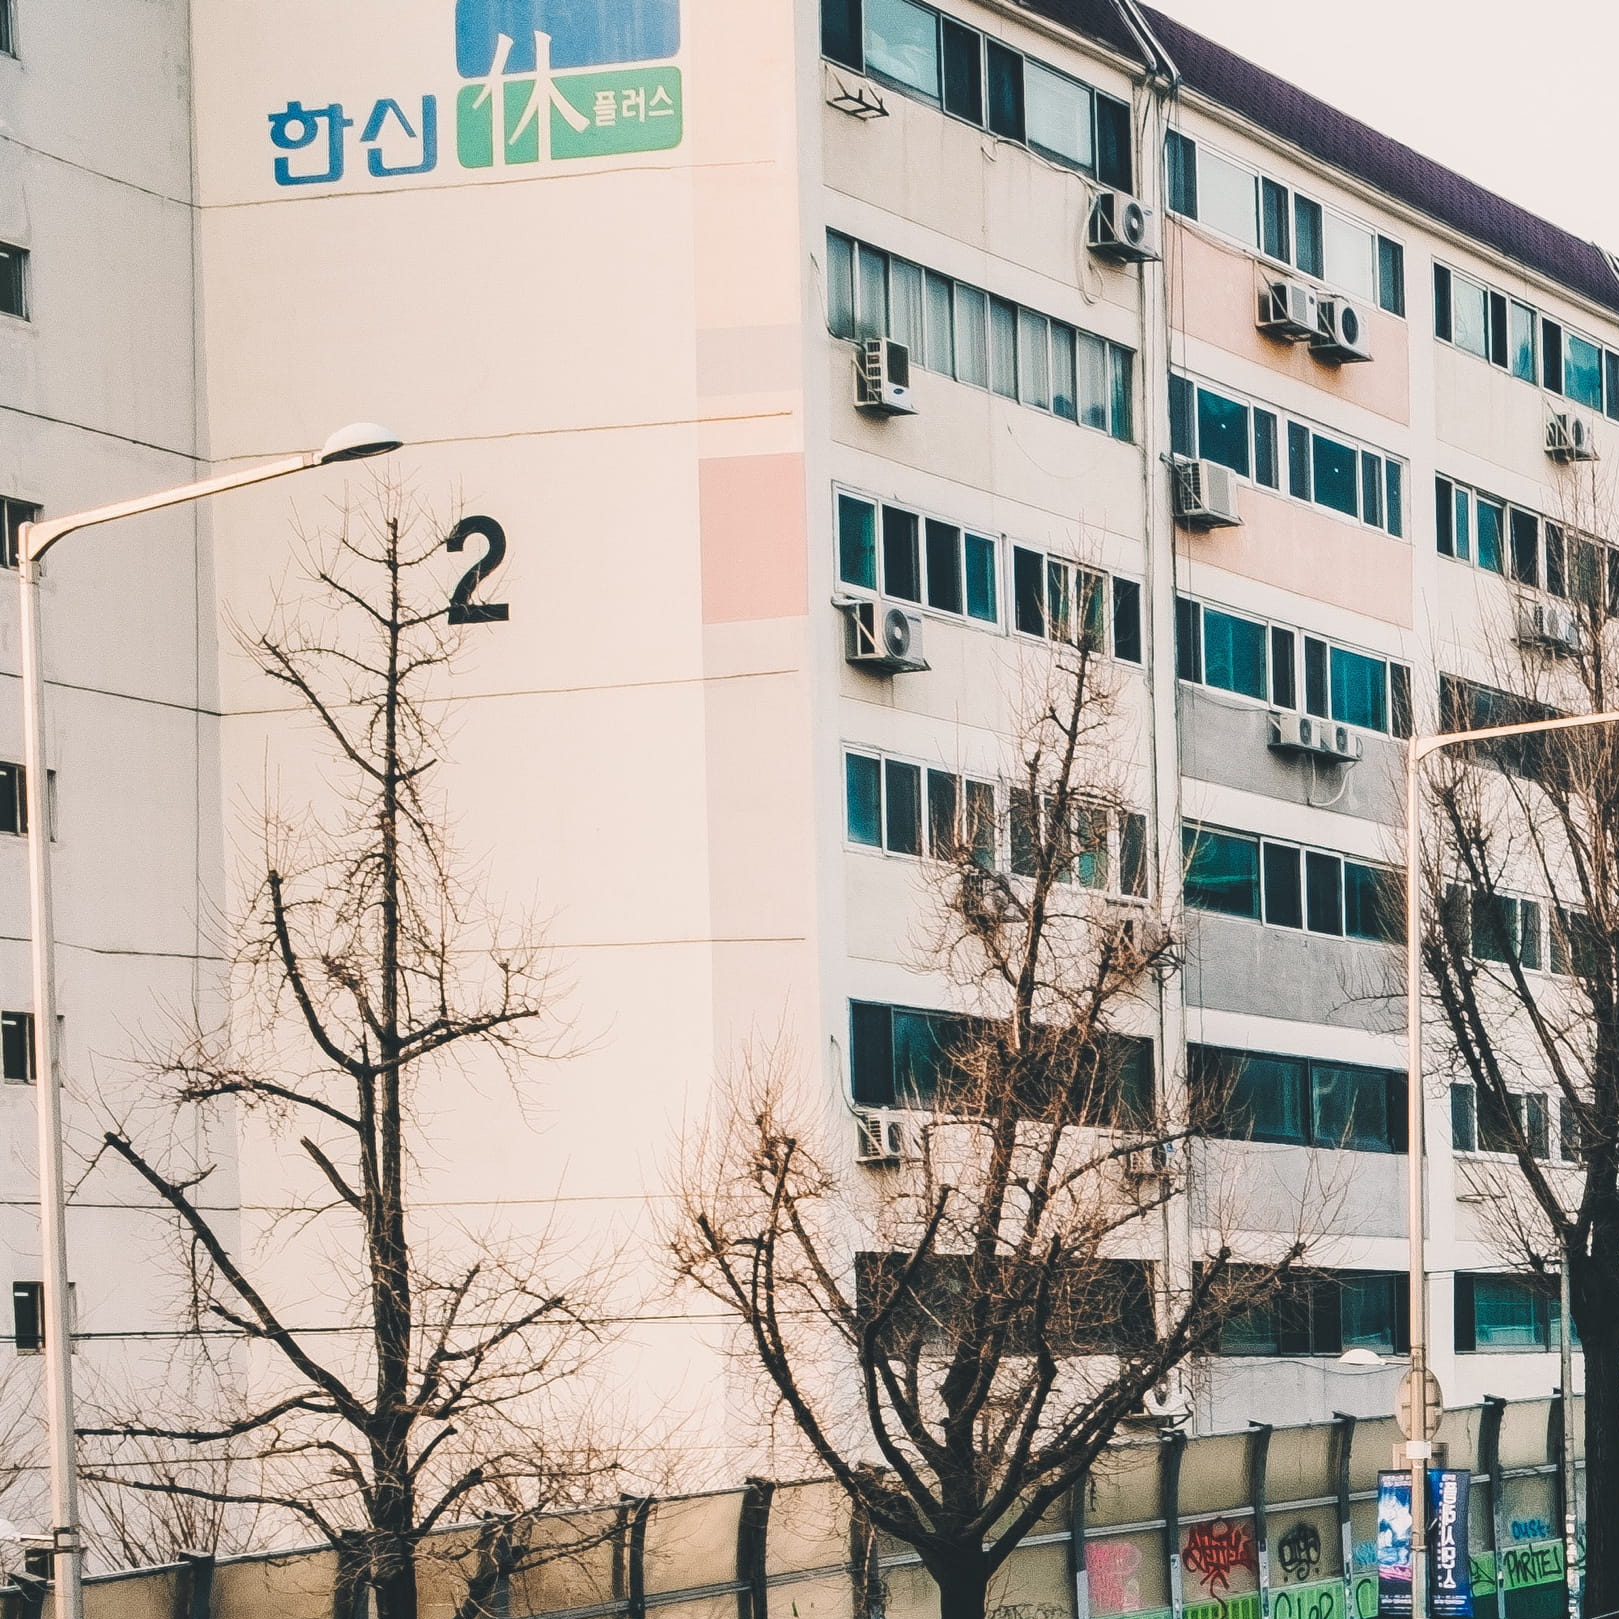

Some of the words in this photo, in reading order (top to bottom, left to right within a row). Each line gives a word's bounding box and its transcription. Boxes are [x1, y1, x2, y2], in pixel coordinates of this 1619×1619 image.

[268, 94, 438, 186] 한신
[472, 30, 590, 168] 休
[592, 85, 676, 127] 플러스
[446, 515, 509, 625] 2
